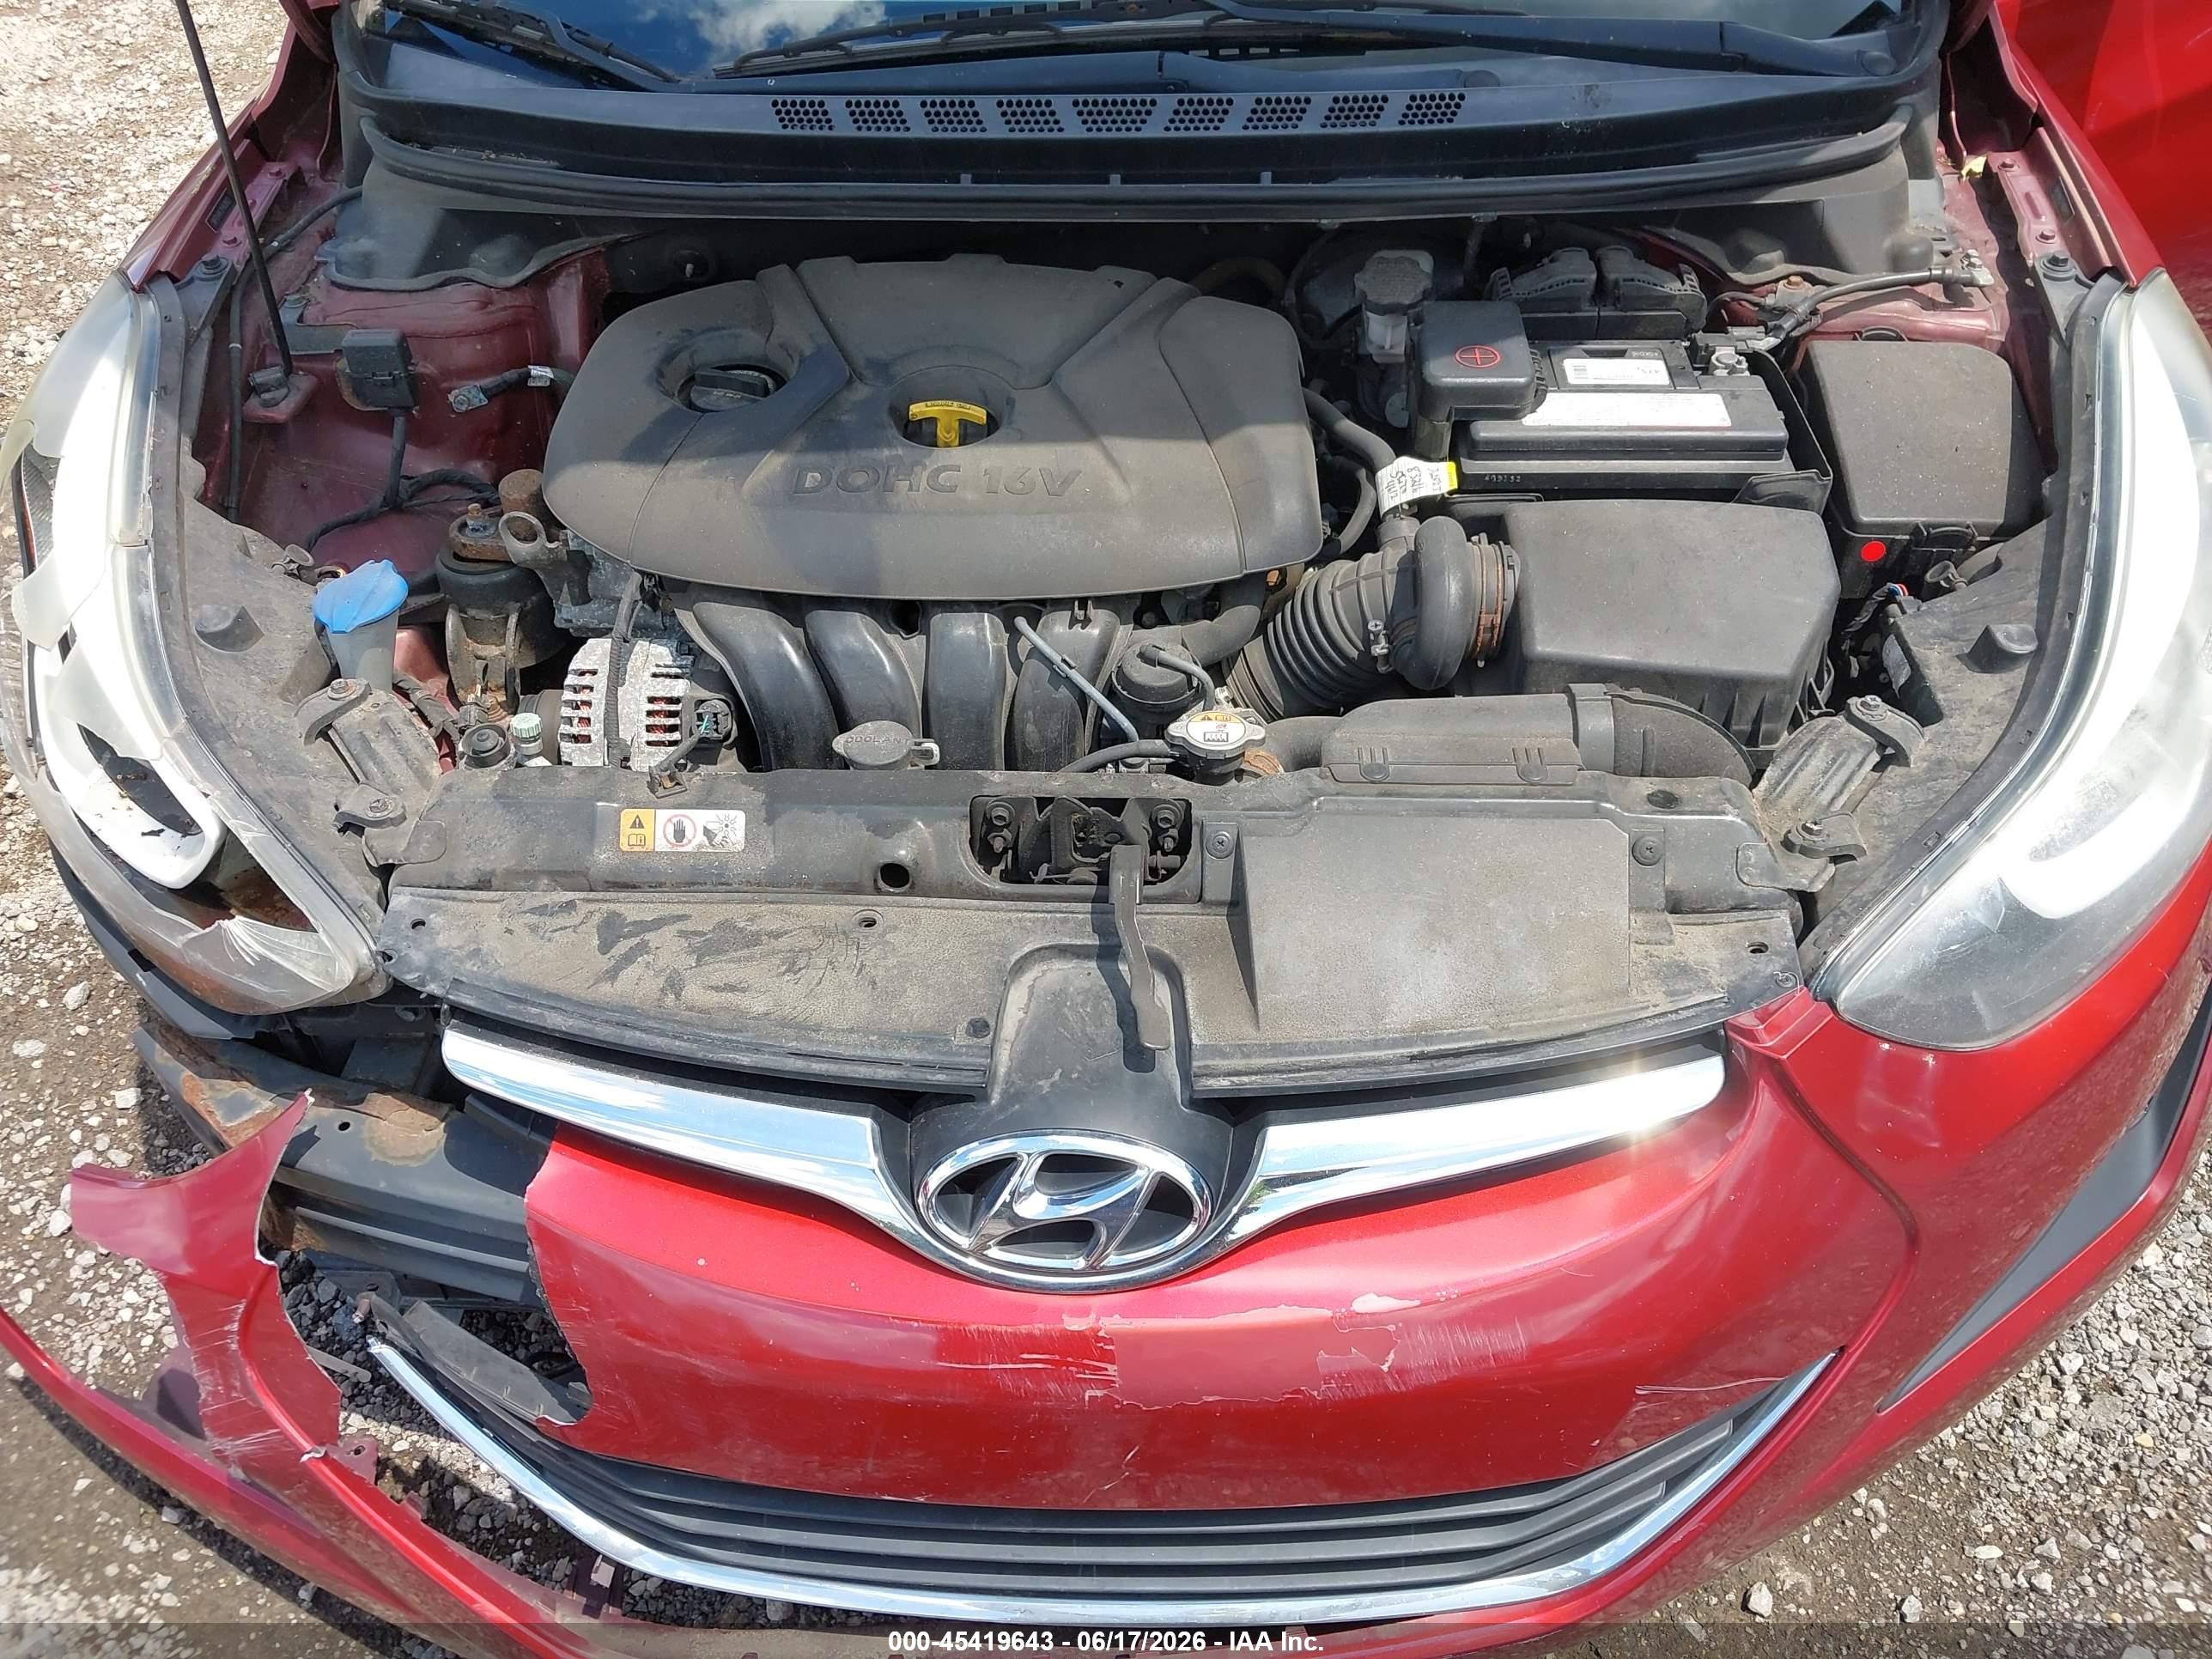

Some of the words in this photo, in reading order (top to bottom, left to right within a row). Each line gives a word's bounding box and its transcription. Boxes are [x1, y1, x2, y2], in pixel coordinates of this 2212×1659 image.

[792, 465, 963, 495] DOHC
[983, 466, 1083, 497] 16V
[845, 734, 909, 745] COOLANT
